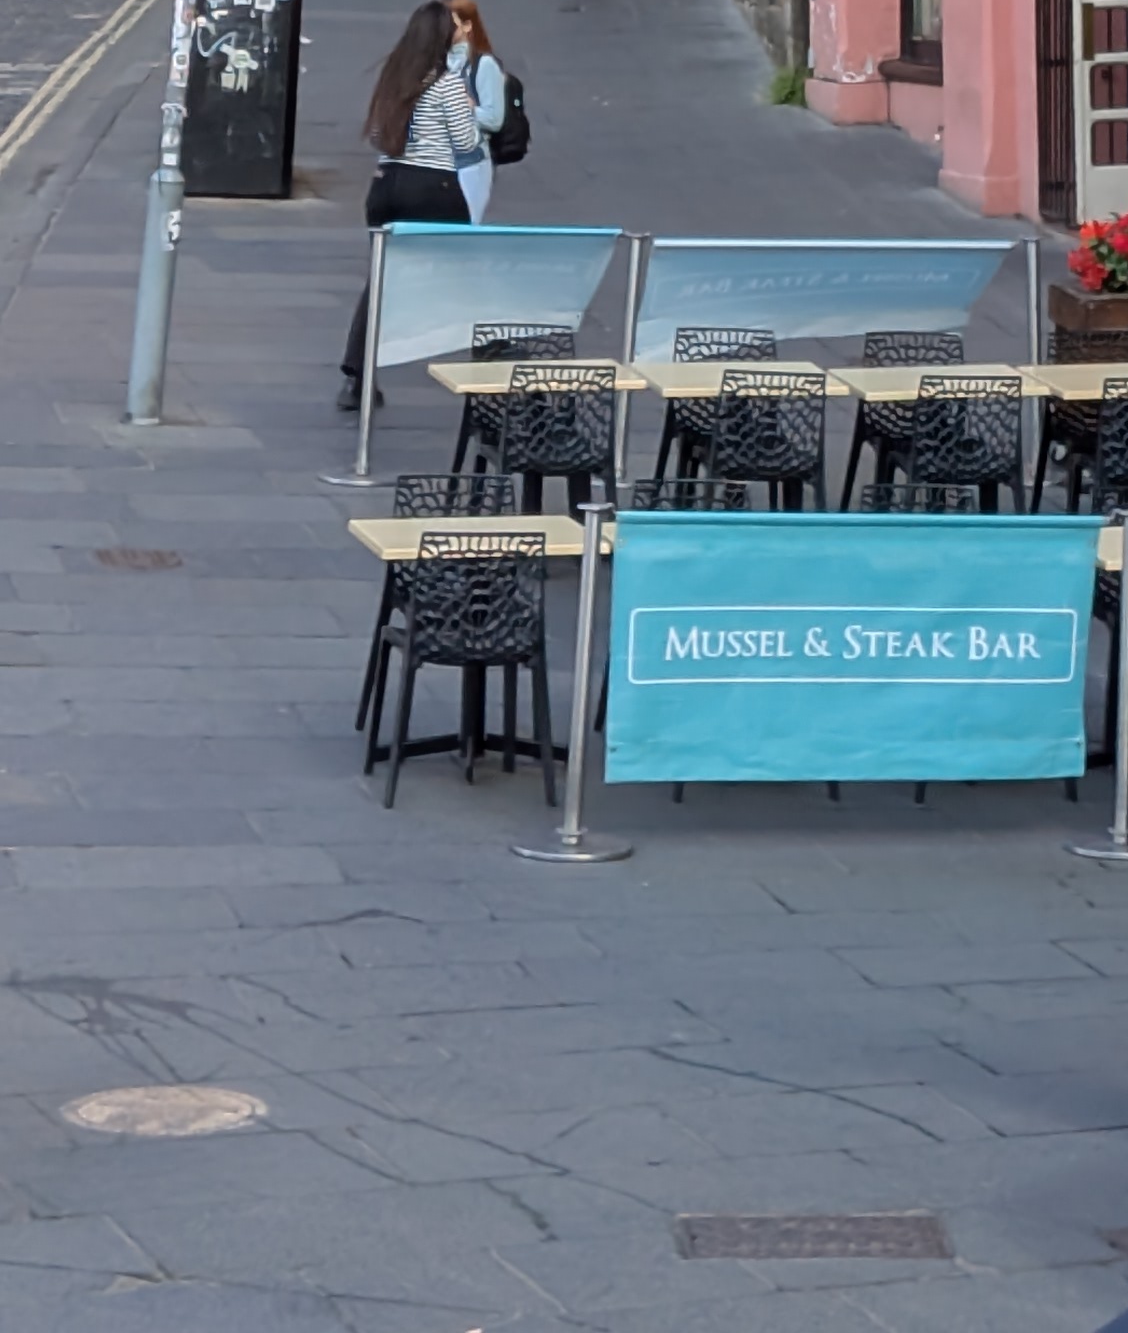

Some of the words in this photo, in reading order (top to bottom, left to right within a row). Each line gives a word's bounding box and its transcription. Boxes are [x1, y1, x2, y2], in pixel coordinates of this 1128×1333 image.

[664, 626, 793, 661] MUSSEL
[803, 627, 832, 659] &
[842, 624, 955, 660] STEAK
[967, 625, 1041, 661] BAR
